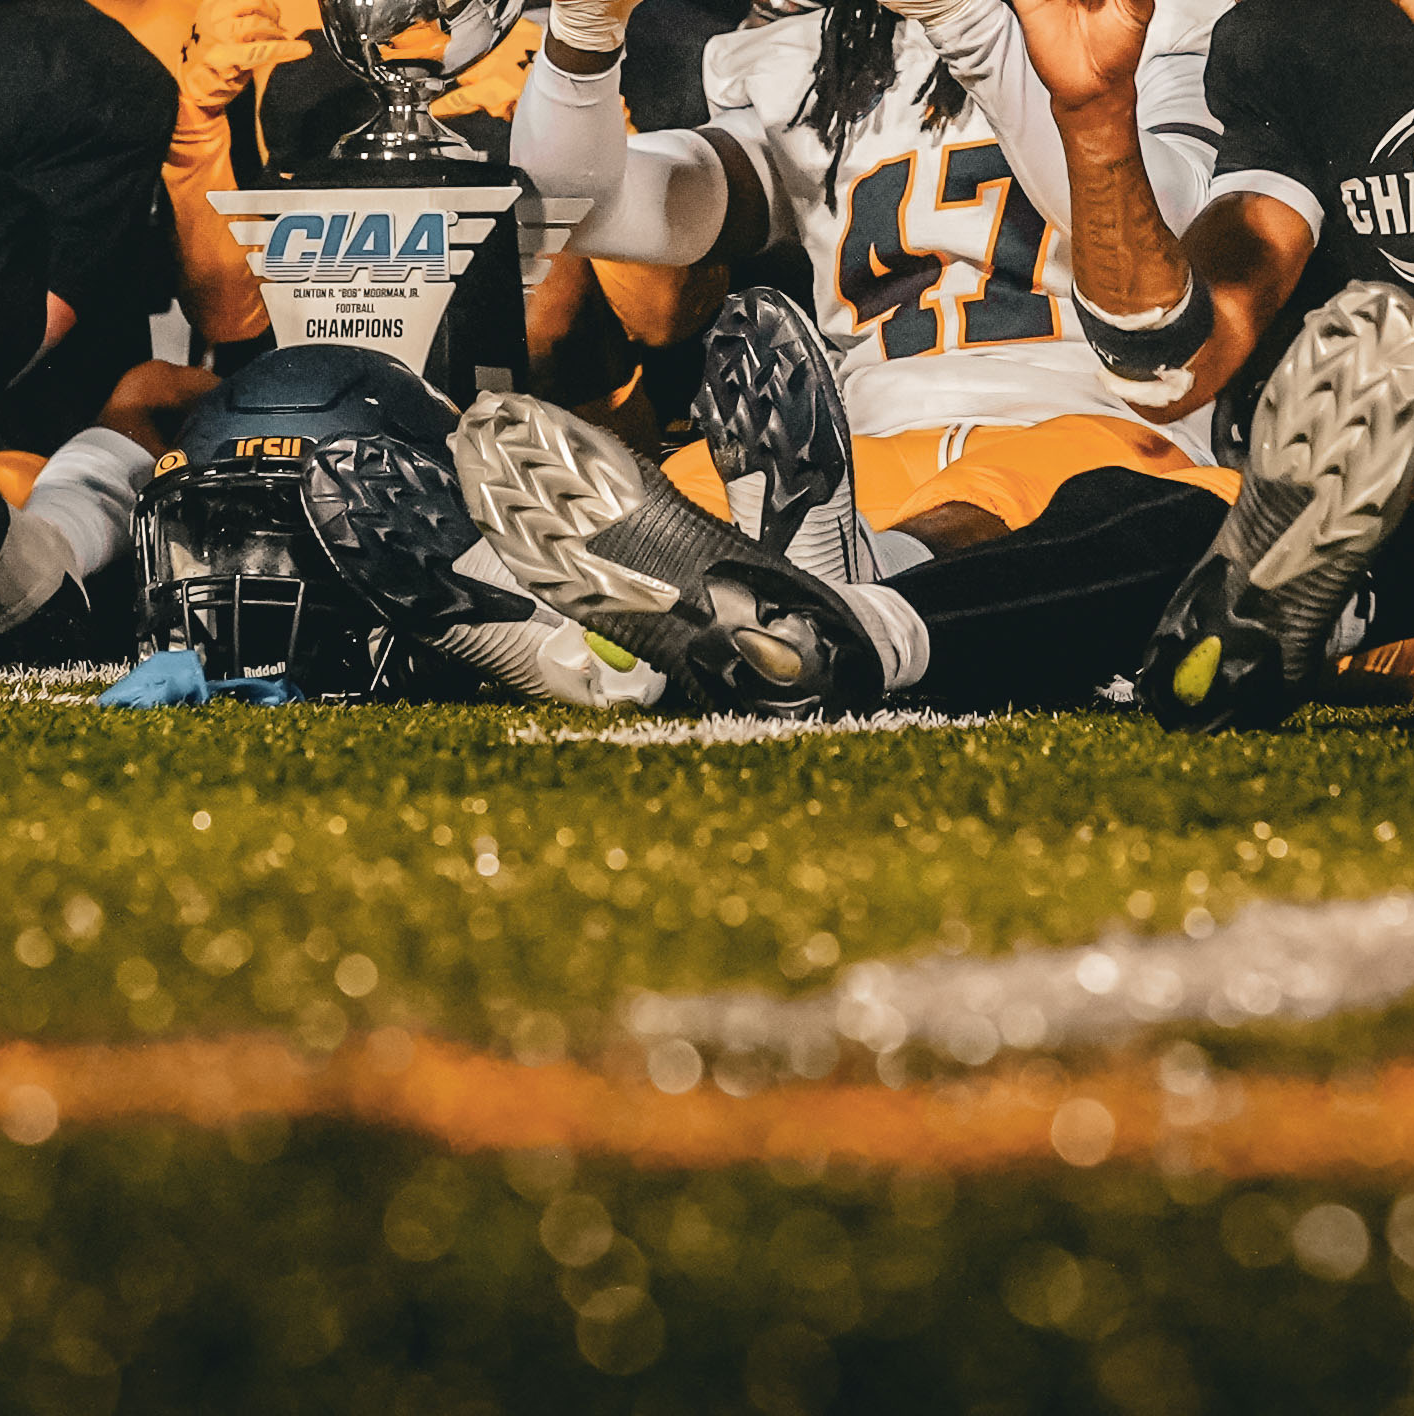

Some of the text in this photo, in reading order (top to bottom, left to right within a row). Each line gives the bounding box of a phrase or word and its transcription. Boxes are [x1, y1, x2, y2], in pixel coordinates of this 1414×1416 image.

[264, 211, 450, 282] CIAA
[834, 139, 1063, 361] 47
[293, 288, 327, 299] CLINTON
[363, 287, 407, 299] MOORMAN,
[335, 302, 375, 314] FOOTBALL
[305, 318, 404, 339] CHAMPIONS
